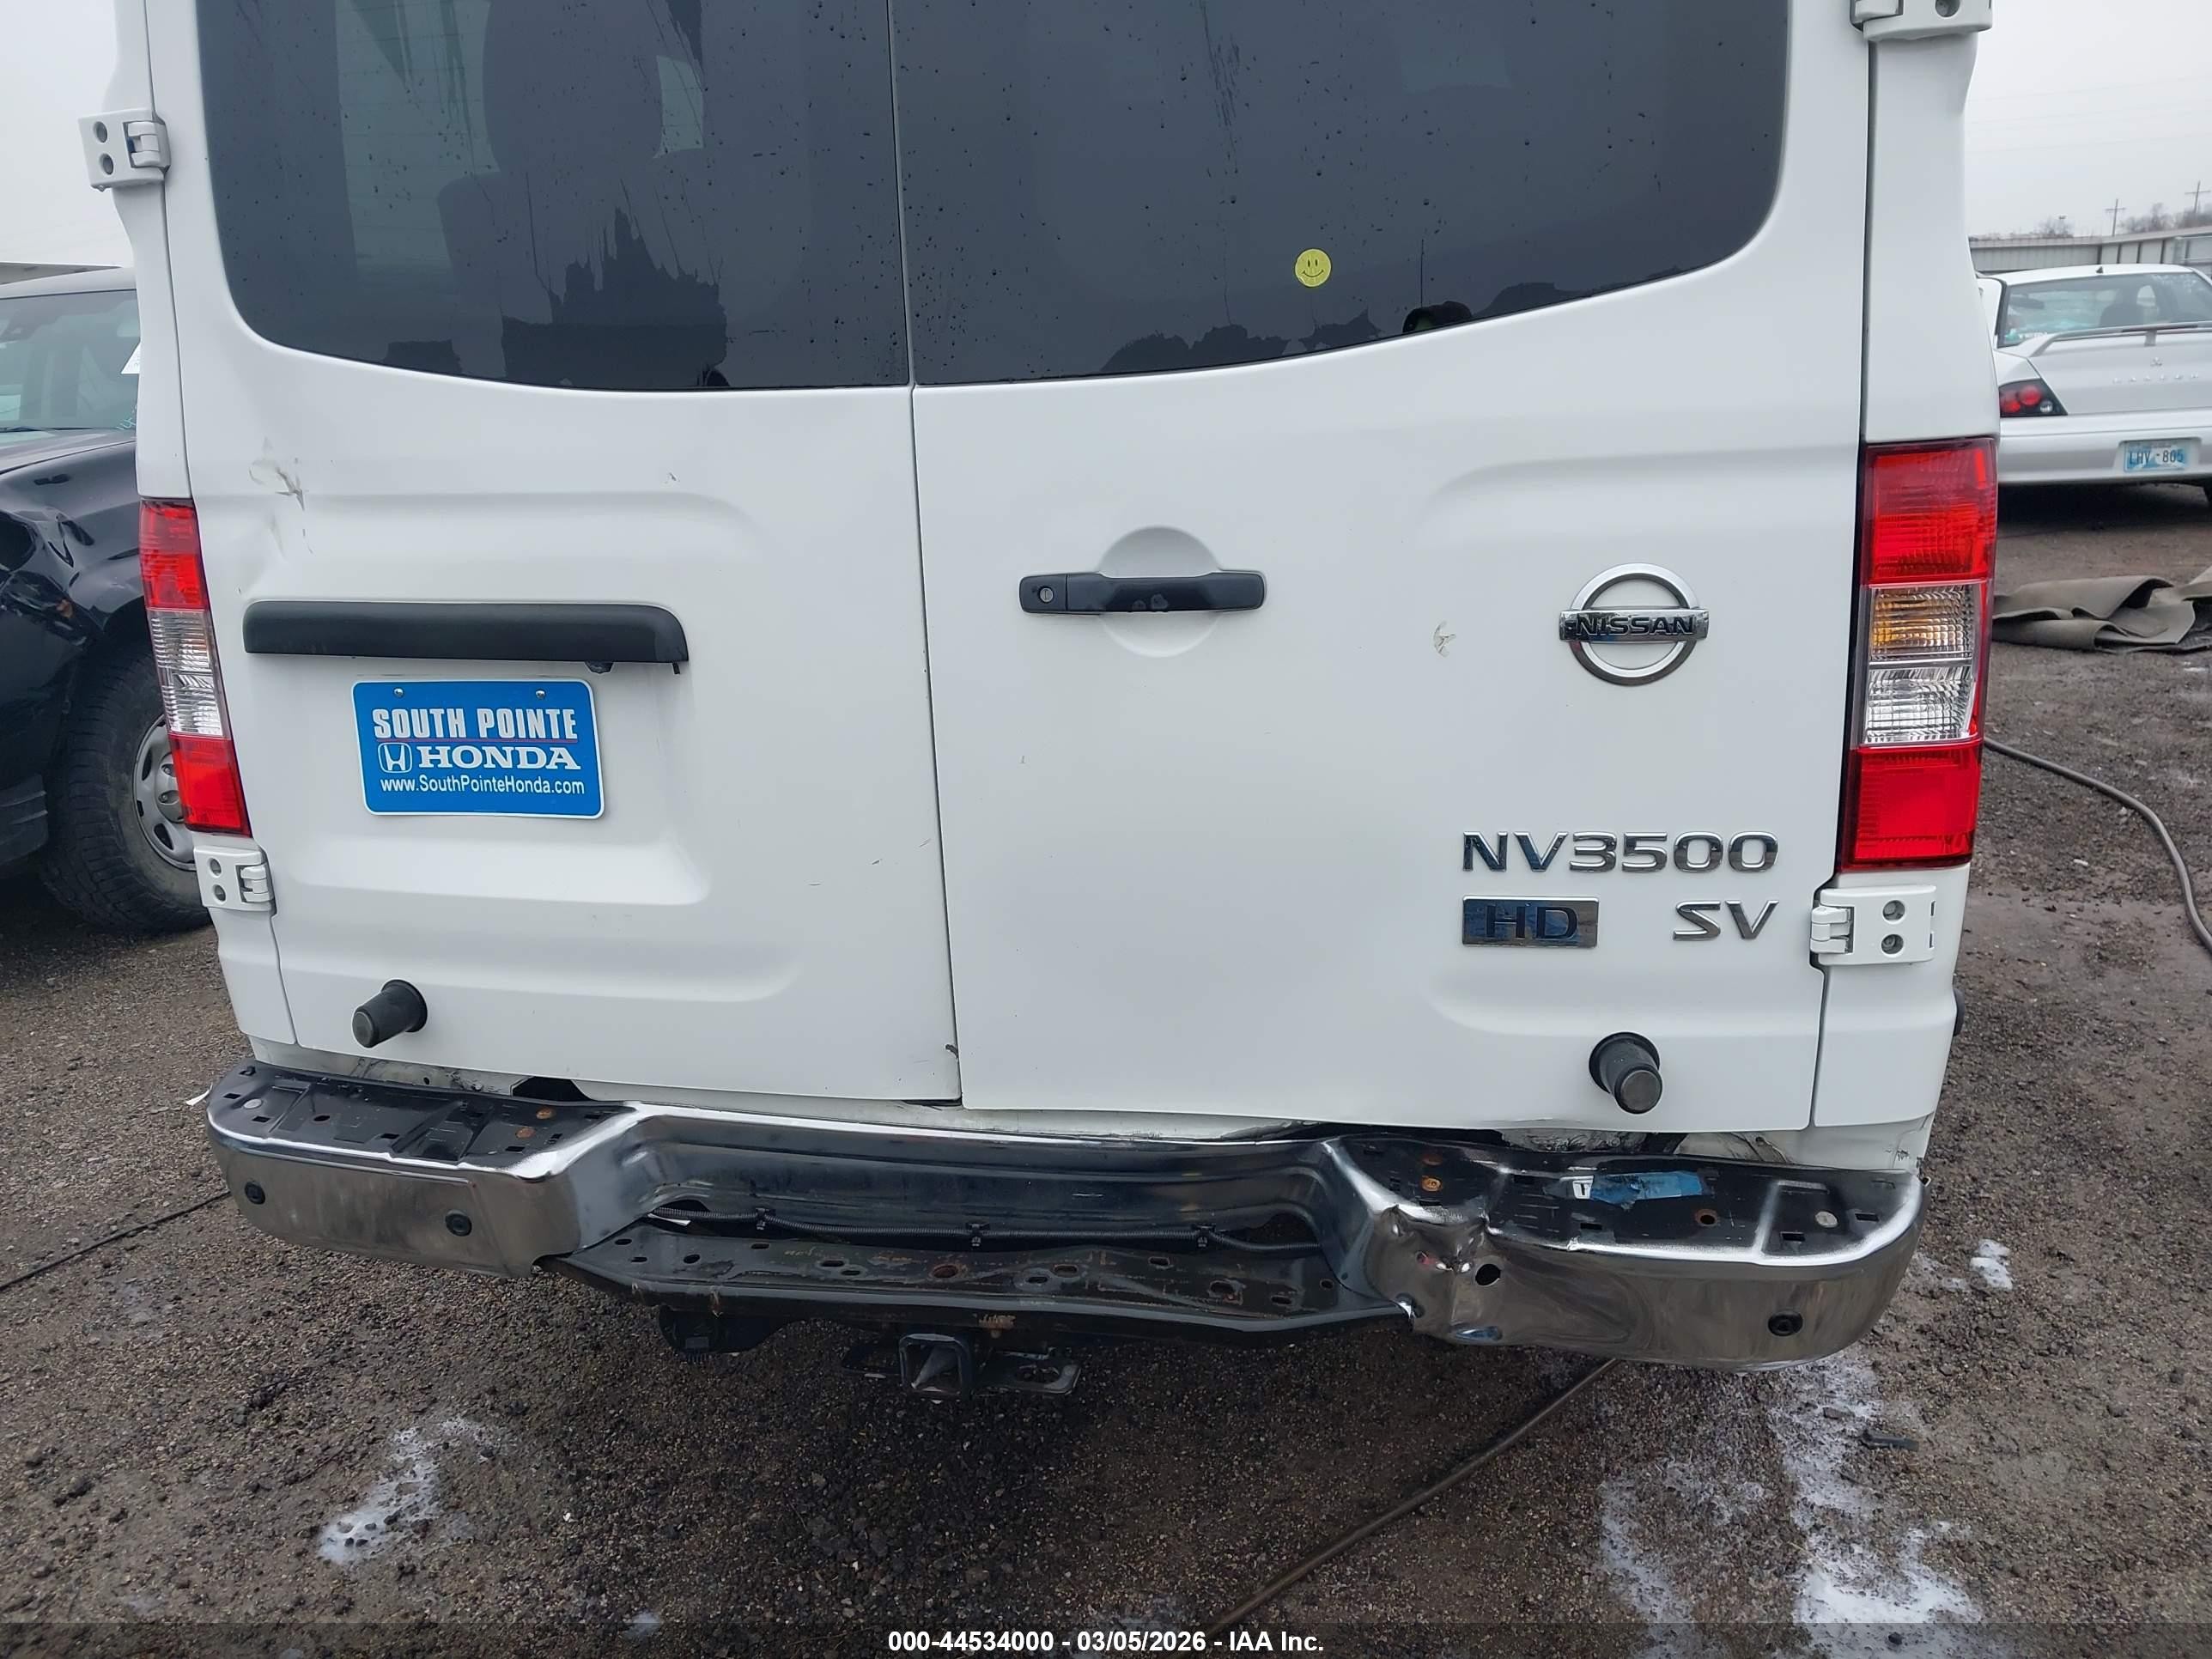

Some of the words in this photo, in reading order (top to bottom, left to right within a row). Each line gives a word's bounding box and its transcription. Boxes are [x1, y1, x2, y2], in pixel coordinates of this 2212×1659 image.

[1576, 612, 1694, 635] NISSAN
[372, 708, 467, 738] SOUTH
[477, 708, 578, 739] POINTE
[416, 745, 581, 770] HONDA
[380, 775, 585, 794] www.SouthPointeHonda.com
[1462, 831, 1779, 872] NV3500
[1485, 903, 1580, 940] HD
[1673, 899, 1780, 941] SV
